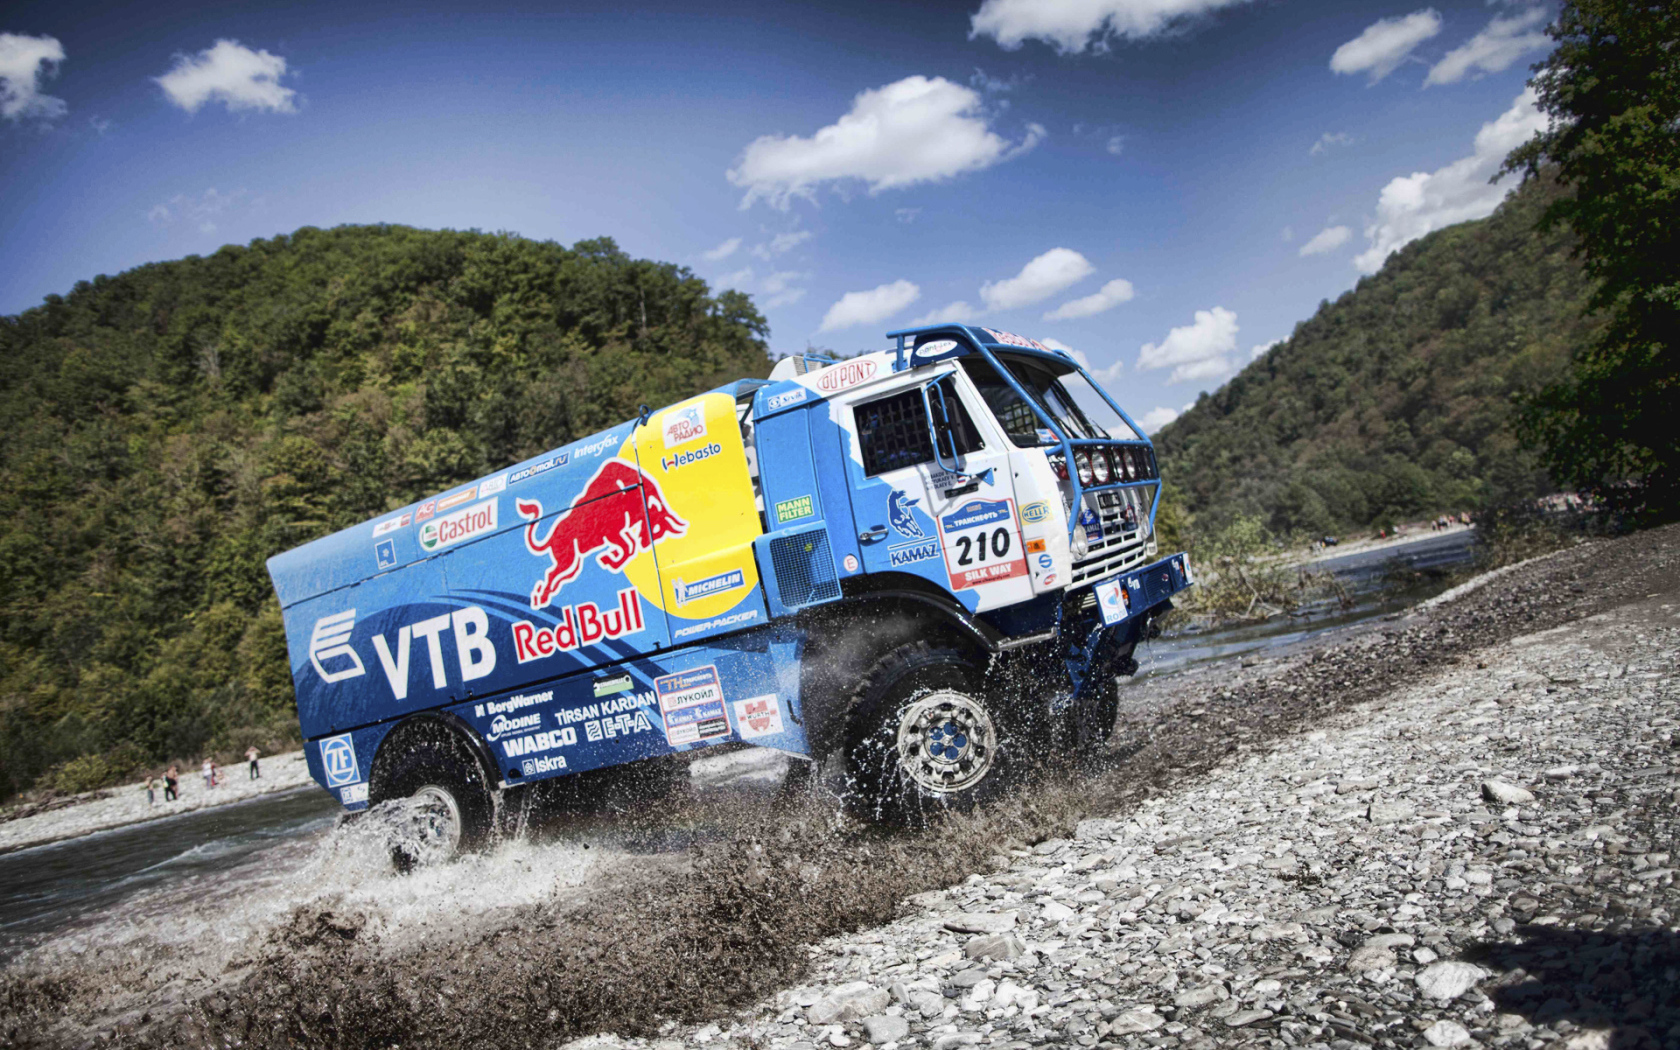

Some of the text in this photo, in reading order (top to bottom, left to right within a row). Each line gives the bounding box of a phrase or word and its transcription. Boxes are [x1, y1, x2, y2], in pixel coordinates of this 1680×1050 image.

[840, 362, 872, 387] PONT
[667, 420, 689, 436] АВТО
[674, 424, 703, 442] РАДИО
[662, 443, 721, 471] Webasto
[777, 497, 810, 513] MANN
[779, 506, 812, 522] FILTER
[1024, 506, 1049, 517] HELLA
[440, 505, 492, 542] Castrol
[954, 512, 998, 527] ТРАНСНЕФТЬ
[891, 544, 940, 567] KAMAZ
[956, 527, 1010, 566] 210
[965, 563, 1012, 581] SILK WAY
[688, 572, 741, 596] MICHELIN
[674, 610, 758, 638] POWER-PACKER
[372, 606, 496, 700] VTB
[487, 691, 553, 715] BorgWarner
[601, 690, 656, 716] KARDAN
[677, 689, 714, 704] ЛУКОЙЛ
[492, 713, 541, 734] MODINE
[502, 727, 577, 757] WABCO
[325, 745, 353, 775] ZF
[534, 755, 567, 773] Iskra
